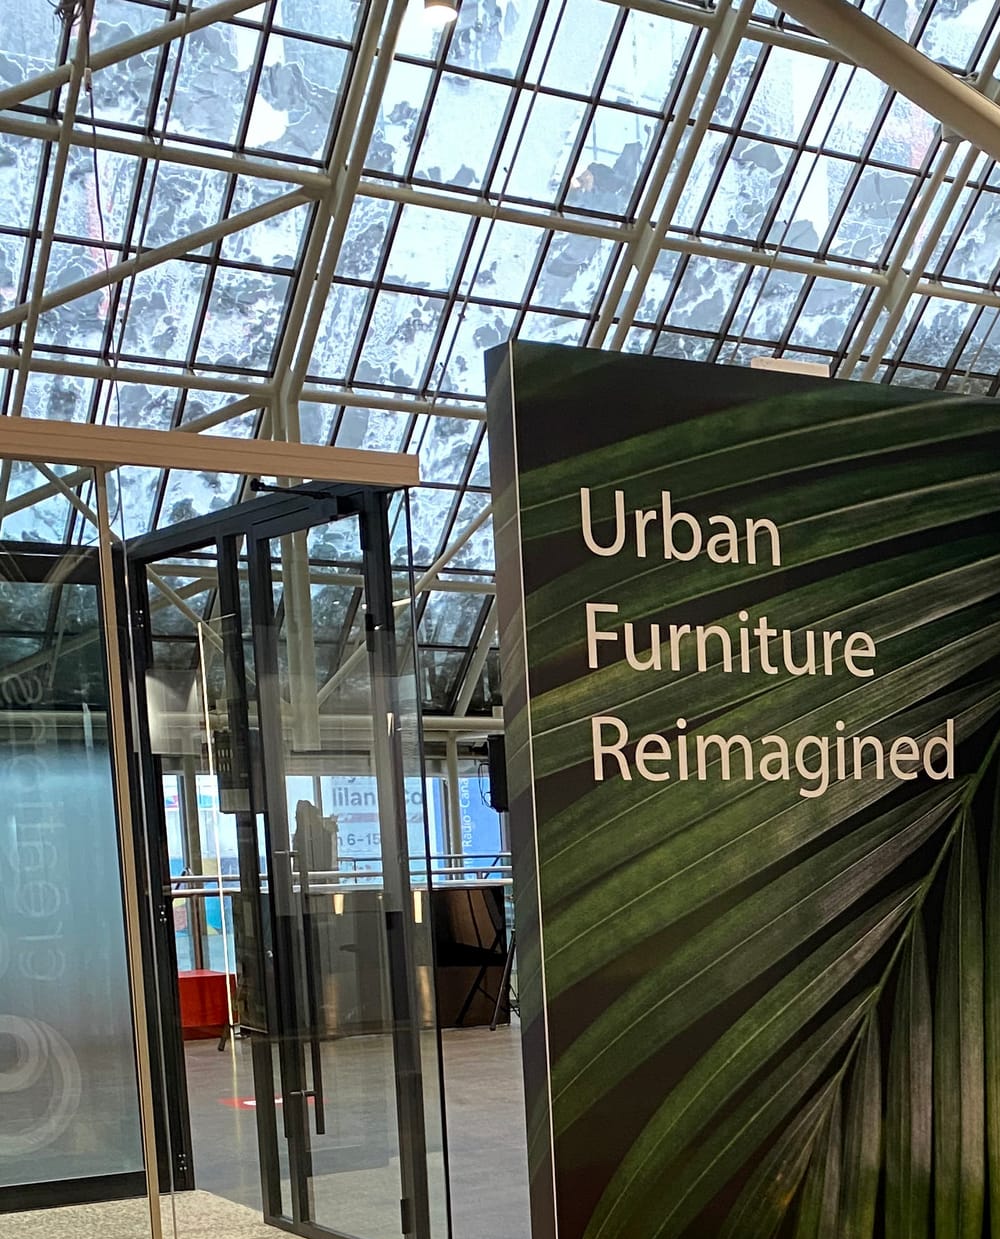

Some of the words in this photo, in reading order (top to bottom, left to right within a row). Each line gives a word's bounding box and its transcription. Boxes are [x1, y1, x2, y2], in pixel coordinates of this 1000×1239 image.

[579, 487, 782, 567] Urban
[585, 602, 876, 677] Furniture
[591, 716, 956, 798] Reimagined
